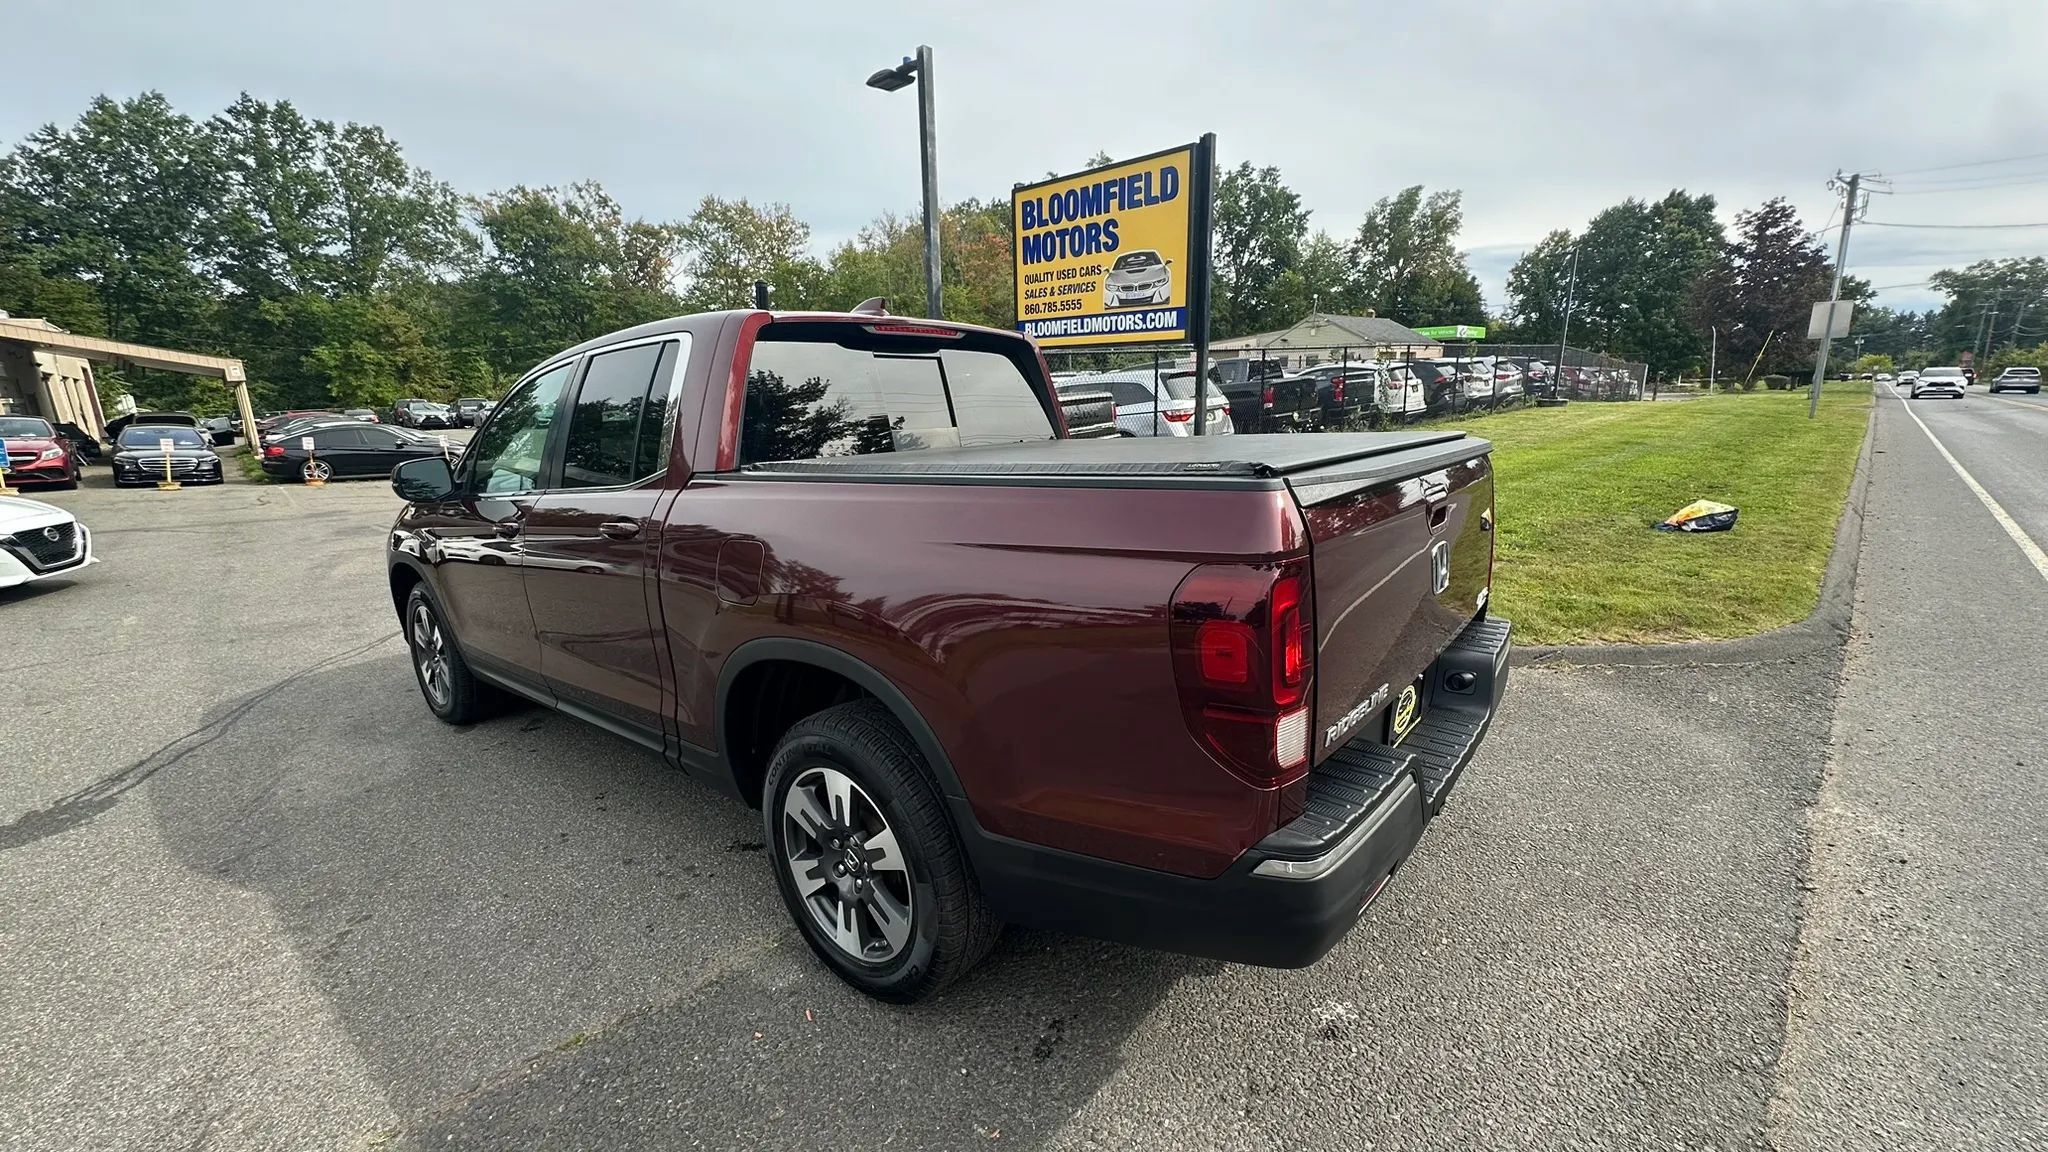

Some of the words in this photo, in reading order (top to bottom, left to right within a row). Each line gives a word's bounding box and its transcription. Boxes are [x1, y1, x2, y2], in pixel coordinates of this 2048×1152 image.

[1021, 166, 1180, 231] BLOOMFIELD
[1022, 218, 1120, 265] MOTORS
[1024, 271, 1054, 285] QUALITY
[1056, 267, 1077, 281] USED
[1079, 264, 1102, 277] CARS
[1024, 286, 1048, 300] SALES
[1049, 285, 1056, 297] &
[1057, 281, 1097, 296] SERVICES
[1024, 299, 1082, 315] 860.785.5555
[1024, 311, 1178, 337] BLOOMFIELDMOTORS.COM
[1324, 682, 1389, 748] RIDGELINE
